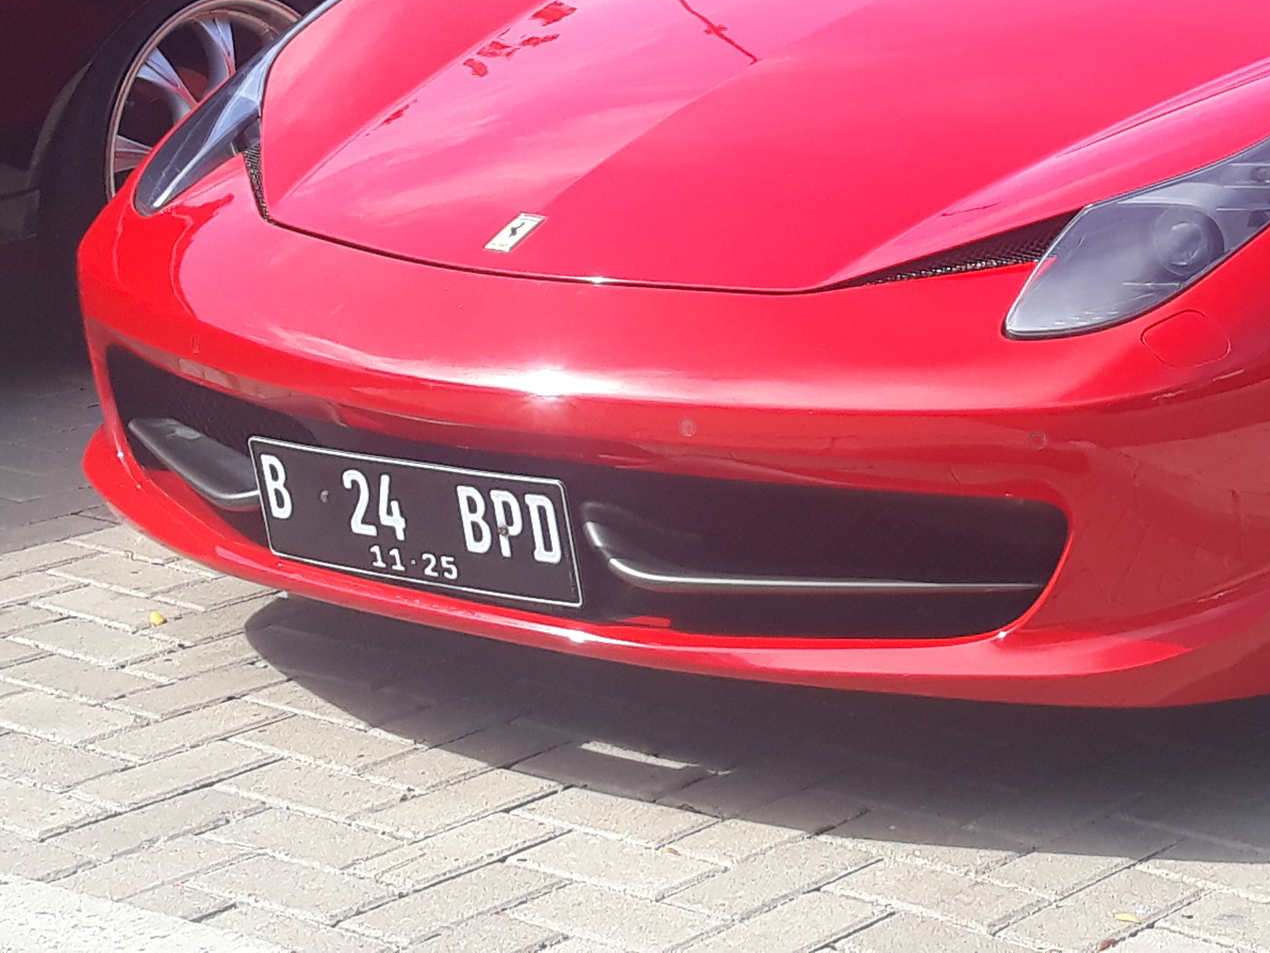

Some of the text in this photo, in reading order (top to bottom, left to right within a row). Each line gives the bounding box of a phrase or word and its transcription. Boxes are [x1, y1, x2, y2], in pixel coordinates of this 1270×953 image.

[260, 453, 562, 564] B 24 BPD
